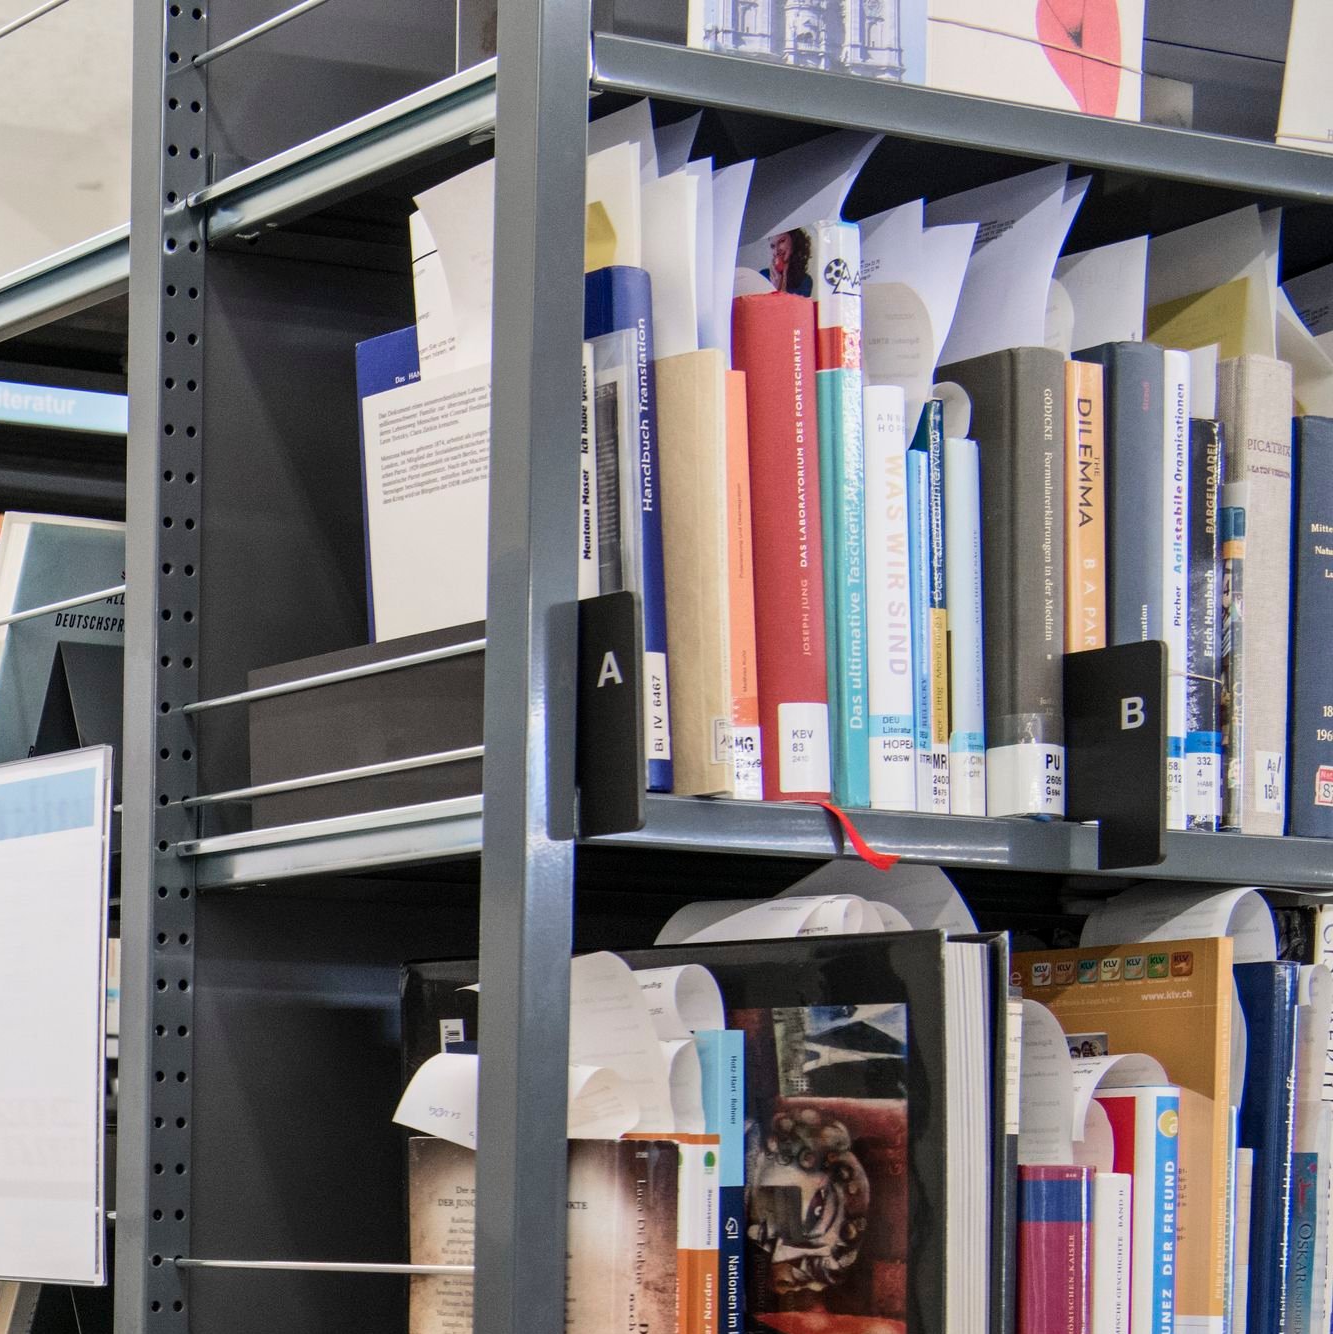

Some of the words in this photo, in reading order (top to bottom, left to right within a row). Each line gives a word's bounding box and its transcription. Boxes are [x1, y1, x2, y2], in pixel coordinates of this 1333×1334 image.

[395, 375, 406, 385] Das
[637, 317, 650, 412] Translation
[793, 328, 803, 417] FORTSCHRITTS
[795, 420, 805, 443] DES
[1175, 382, 1185, 482] Organisationen
[639, 418, 654, 512] Handbuch
[1077, 397, 1094, 528] DILEMMA
[582, 469, 590, 505] Moser
[795, 446, 808, 538] LABORATORIUM
[885, 454, 903, 522] WAS
[1042, 451, 1055, 563] Formularerklärungen
[583, 508, 592, 560] Mentona
[1174, 488, 1184, 574] Agilstabile
[800, 543, 808, 567] DAS
[887, 532, 905, 591] WIR
[1045, 566, 1054, 576] in
[800, 579, 810, 611] JUNG
[1045, 579, 1054, 596] der
[1204, 569, 1215, 622] Hambach
[802, 612, 811, 656] JOSEPH
[1045, 598, 1055, 641] Medizin
[848, 595, 862, 690] ultimative
[888, 601, 908, 676] SIND
[1204, 624, 1214, 657] Erich
[597, 651, 624, 688] A
[652, 675, 663, 708] 6467
[849, 694, 863, 729] Das
[883, 716, 900, 724] DEU
[1121, 697, 1145, 730] B
[792, 729, 813, 739] KBV
[792, 743, 804, 752] 83
[883, 754, 910, 762] wasw
[933, 753, 947, 769] MR
[1045, 753, 1061, 770] PU
[1141, 990, 1193, 1002] www.klv.ch
[637, 1179, 647, 1213] Luca
[1163, 1161, 1176, 1234] FREUND
[635, 1241, 646, 1286] Fulvio
[1162, 1241, 1174, 1276] DER
[1295, 1223, 1313, 1284] OSKAR
[703, 1273, 713, 1319] Norden
[728, 1255, 739, 1315] Nationen
[727, 1317, 738, 1328] im
